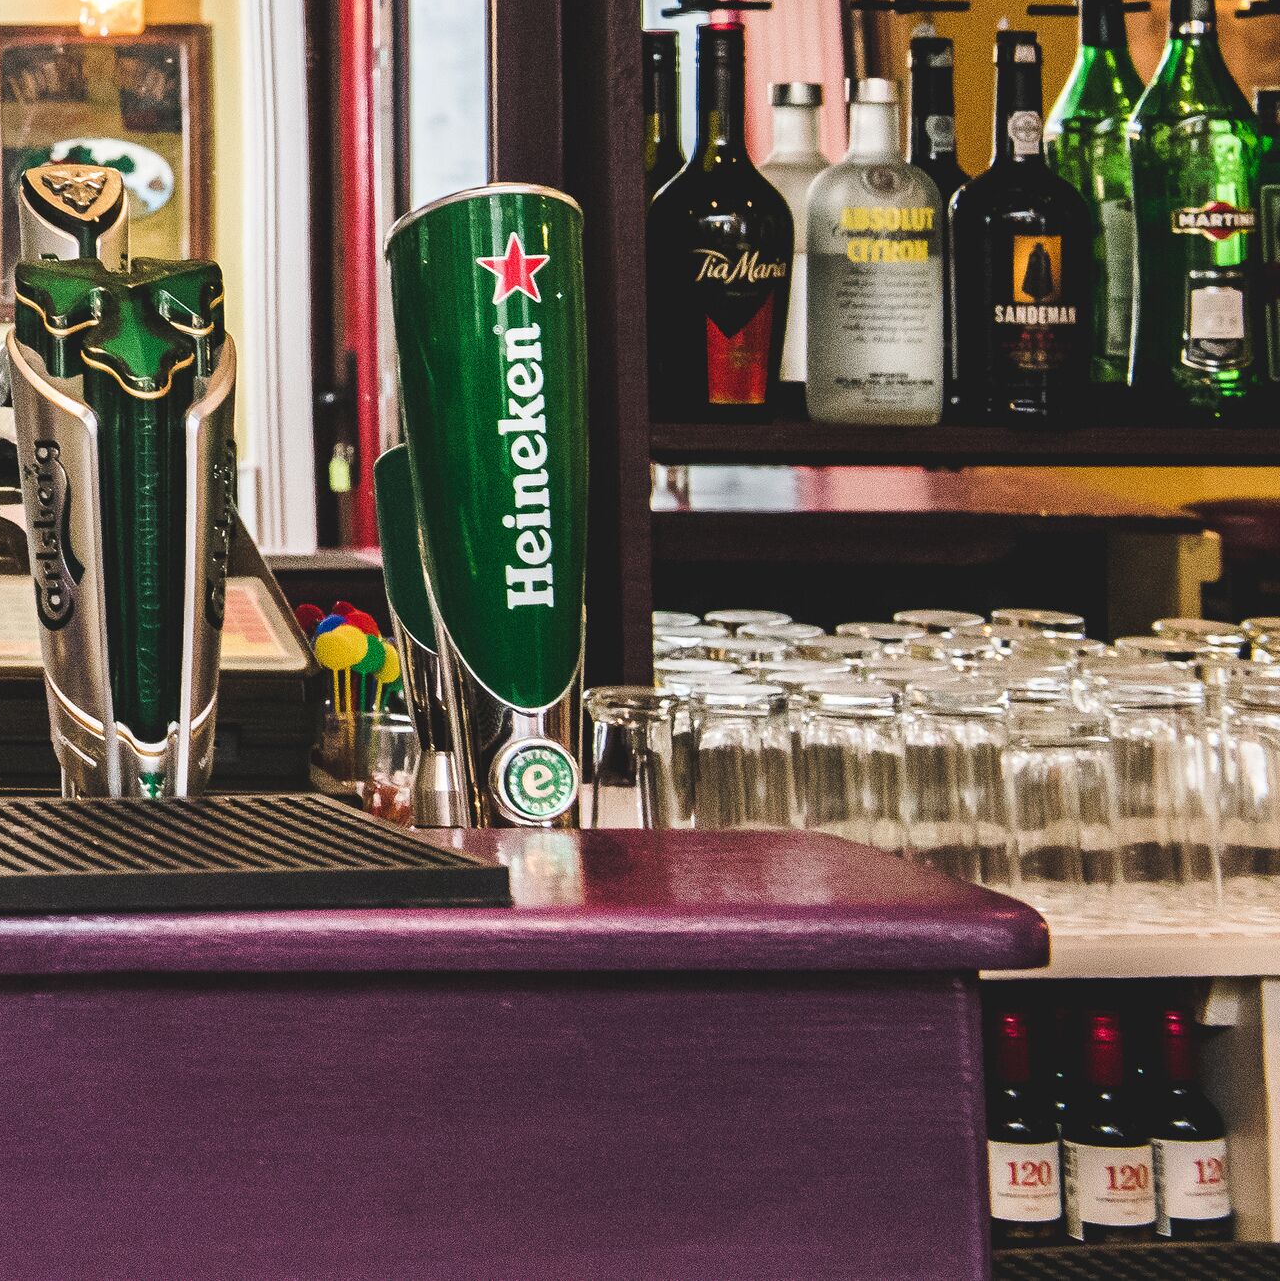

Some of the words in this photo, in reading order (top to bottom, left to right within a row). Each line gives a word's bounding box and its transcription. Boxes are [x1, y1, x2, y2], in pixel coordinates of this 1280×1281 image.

[842, 207, 935, 230] ABSOLUT
[847, 239, 929, 263] CITRON
[692, 248, 728, 282] Tia
[725, 250, 787, 284] Maria
[498, 322, 554, 610] Heineken
[28, 438, 77, 632] Carlsberg
[1007, 1160, 1052, 1187] 120
[1106, 1163, 1149, 1192] 120
[1194, 1158, 1225, 1186] 12
